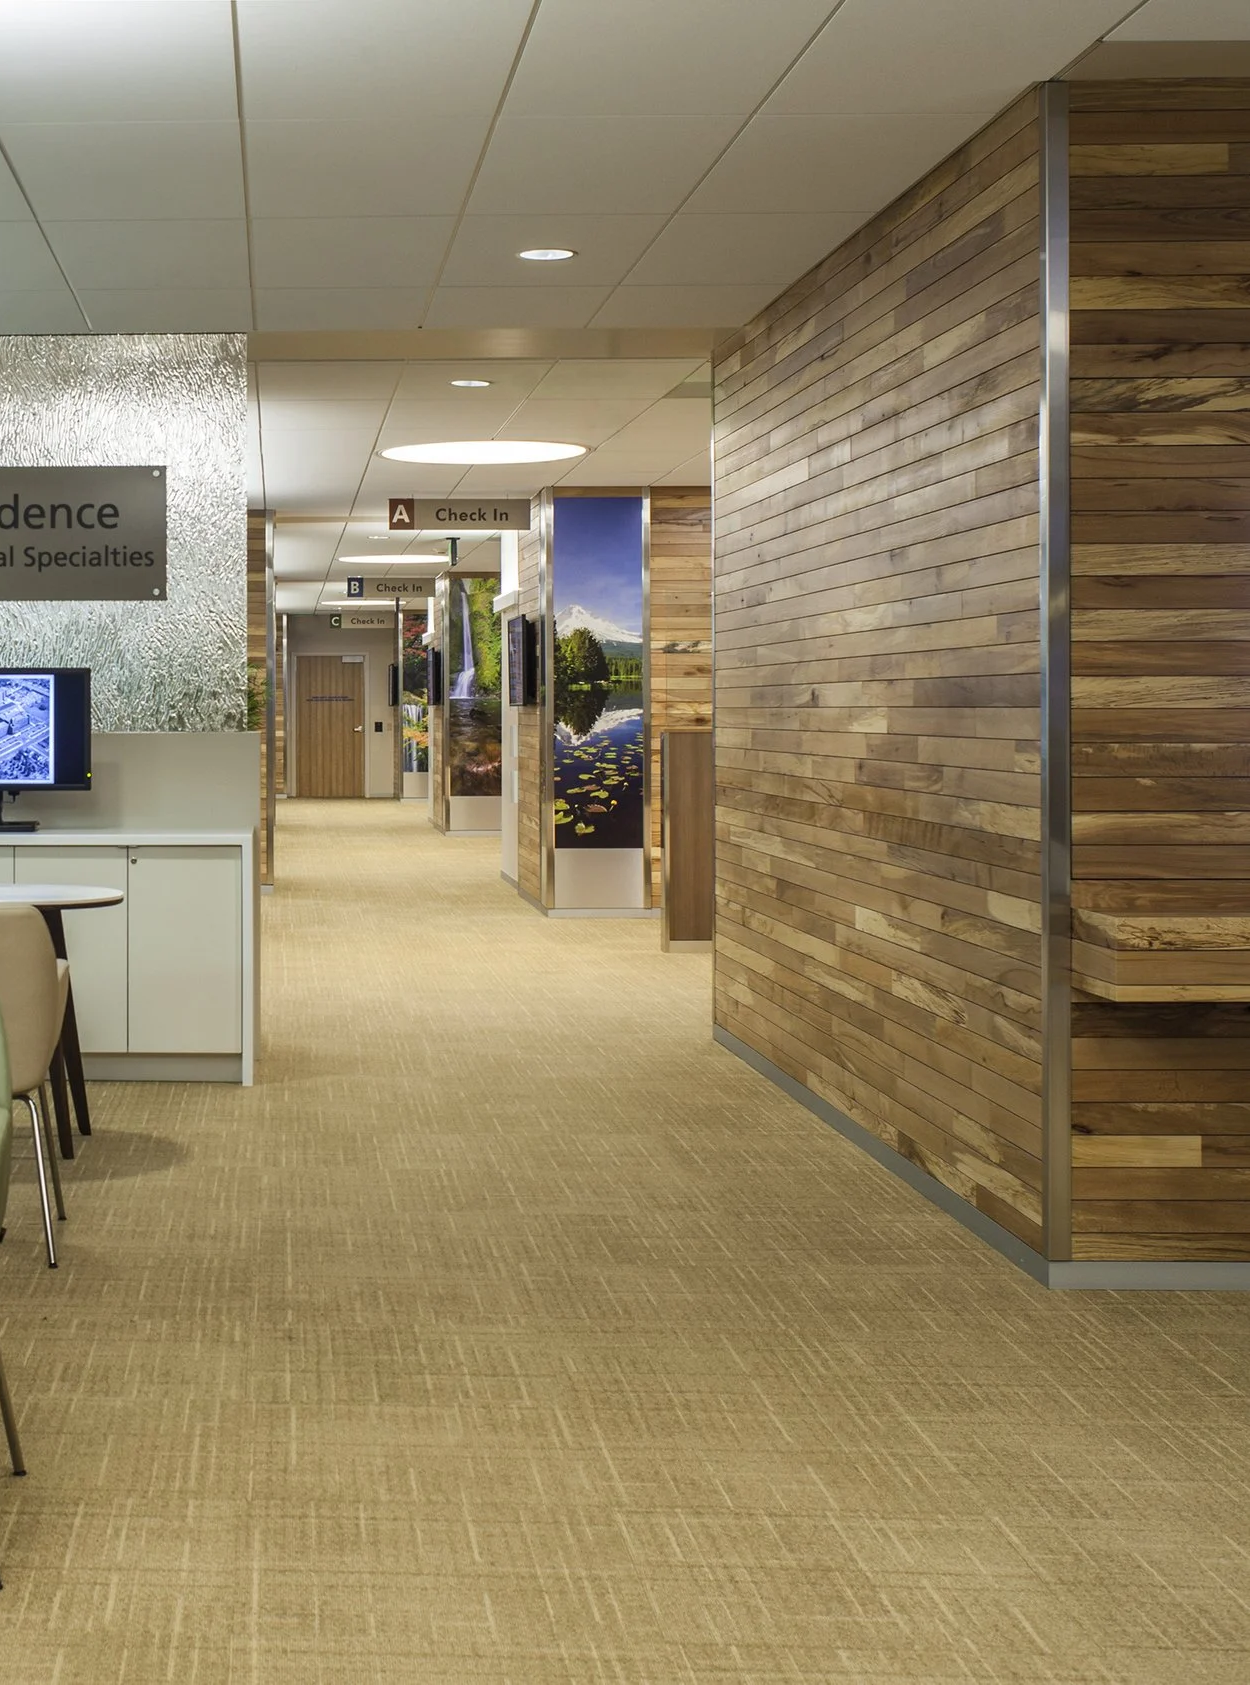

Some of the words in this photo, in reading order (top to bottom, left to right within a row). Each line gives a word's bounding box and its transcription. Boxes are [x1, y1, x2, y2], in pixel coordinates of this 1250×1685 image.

[391, 504, 410, 523] A
[435, 508, 487, 521] Check
[493, 508, 509, 521] In
[24, 545, 155, 572] Specialties
[350, 581, 360, 594] B
[376, 583, 409, 593] Check
[412, 583, 423, 593] In
[331, 616, 340, 626] C
[350, 617, 375, 625] Check
[377, 617, 385, 625] In
